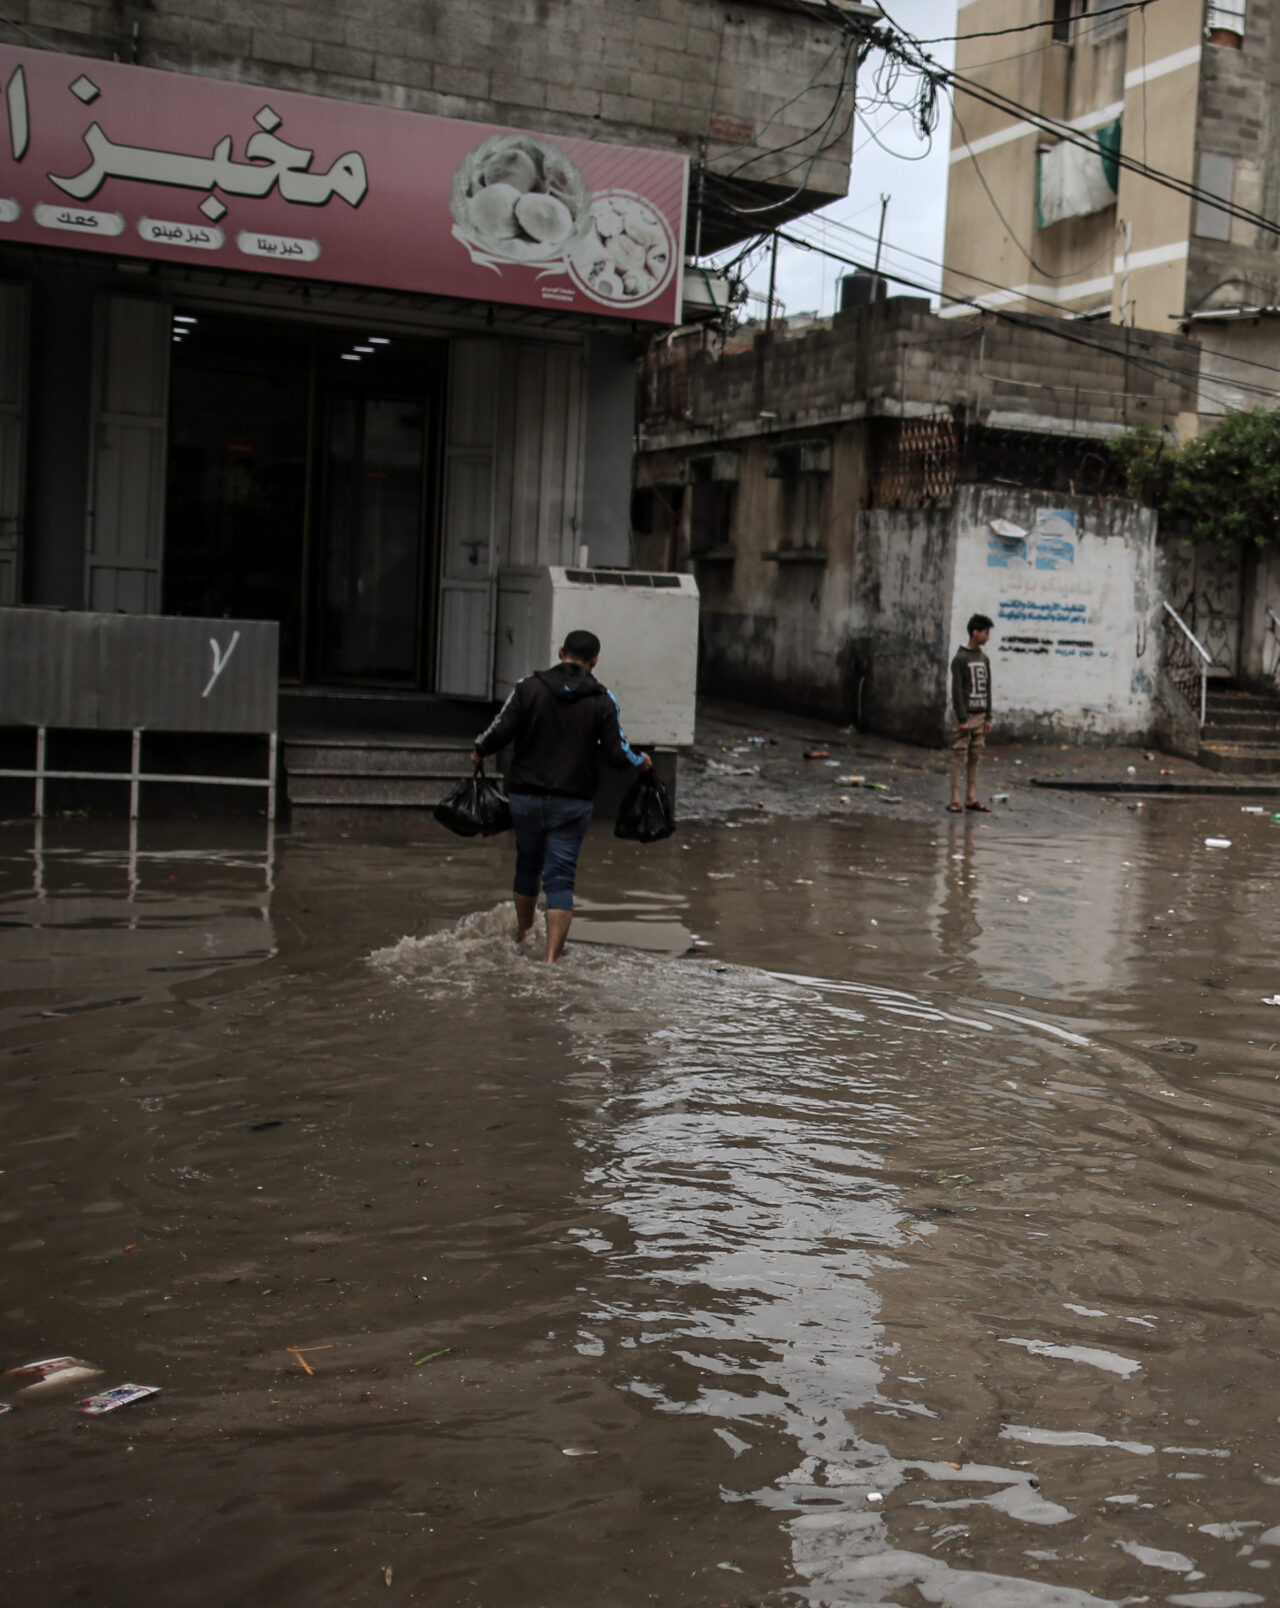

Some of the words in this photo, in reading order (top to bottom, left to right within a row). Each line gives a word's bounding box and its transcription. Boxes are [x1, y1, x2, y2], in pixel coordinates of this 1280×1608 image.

[47, 73, 369, 223] مخبز
[56, 212, 98, 228] كعك
[152, 225, 183, 239] فينو
[185, 228, 210, 243] خبز
[257, 237, 278, 252] بيتا
[279, 242, 304, 256] خبز
